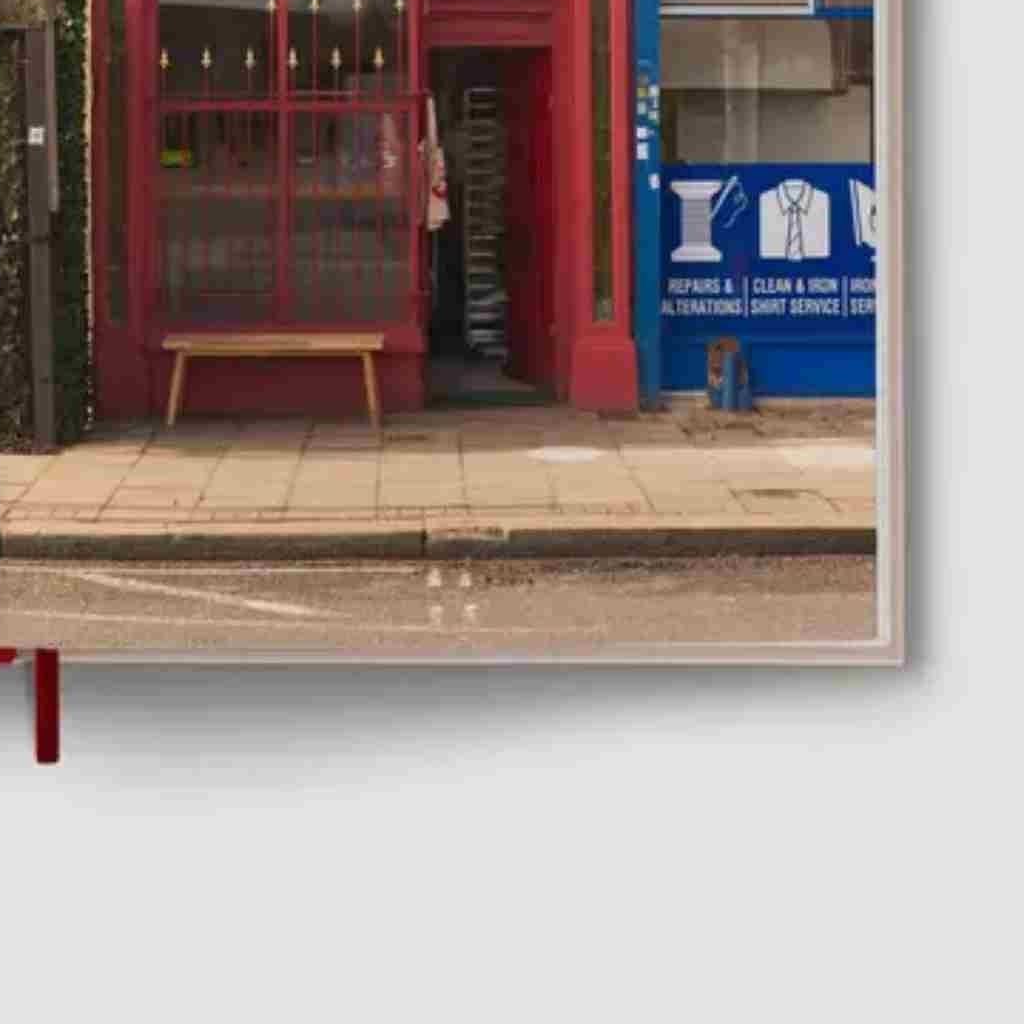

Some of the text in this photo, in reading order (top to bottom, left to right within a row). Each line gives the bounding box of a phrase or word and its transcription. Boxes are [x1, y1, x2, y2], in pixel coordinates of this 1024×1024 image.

[668, 278, 720, 294] REPAIRS
[753, 278, 792, 294] CLEAN
[808, 278, 838, 294] IRON
[751, 298, 841, 315] SHIRT SERVICE
